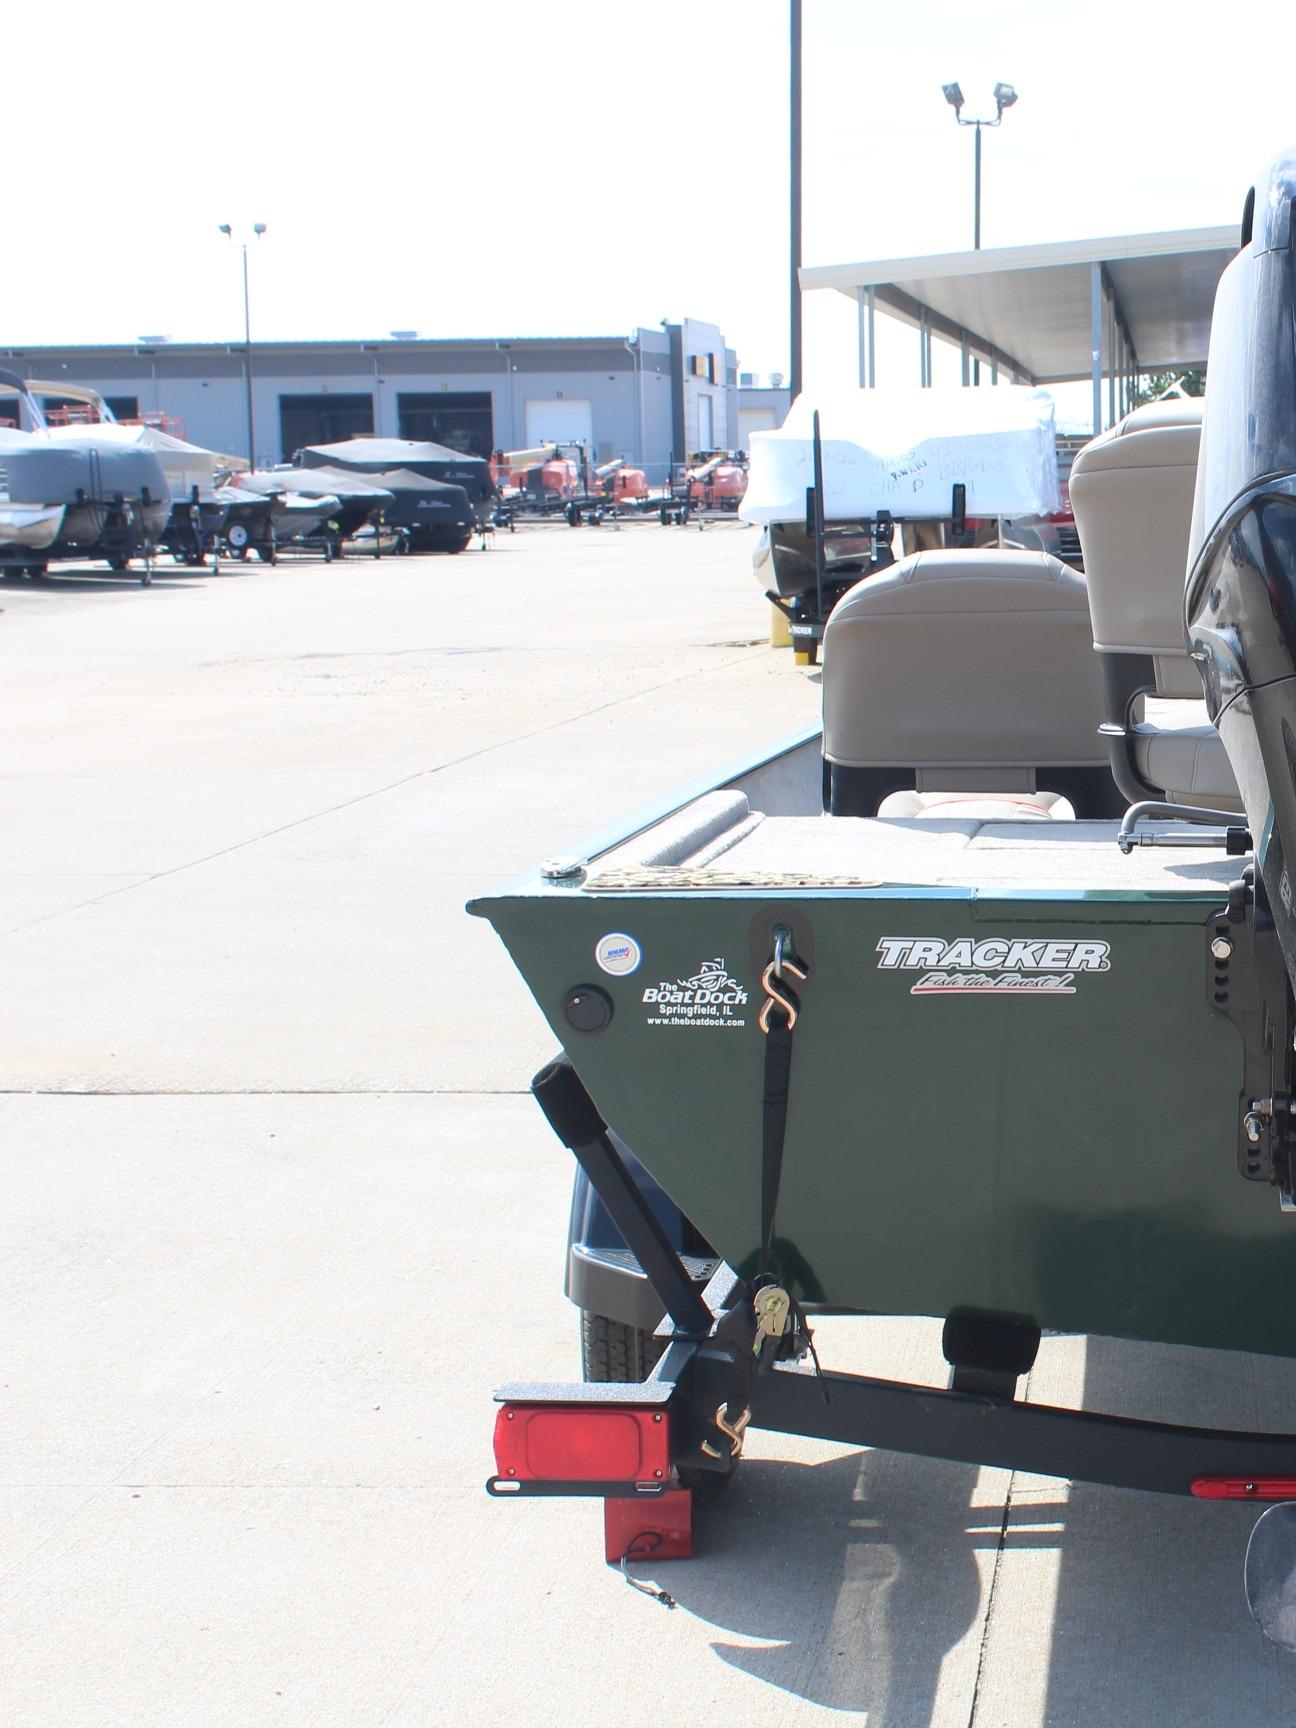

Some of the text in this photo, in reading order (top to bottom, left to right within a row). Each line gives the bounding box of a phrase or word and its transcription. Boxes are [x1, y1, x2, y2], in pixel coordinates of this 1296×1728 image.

[877, 938, 1109, 971] TRACKER
[659, 982, 678, 992] The
[659, 1003, 734, 1017] Springfield, IL
[647, 1017, 746, 1027] www.theboatdock.com
